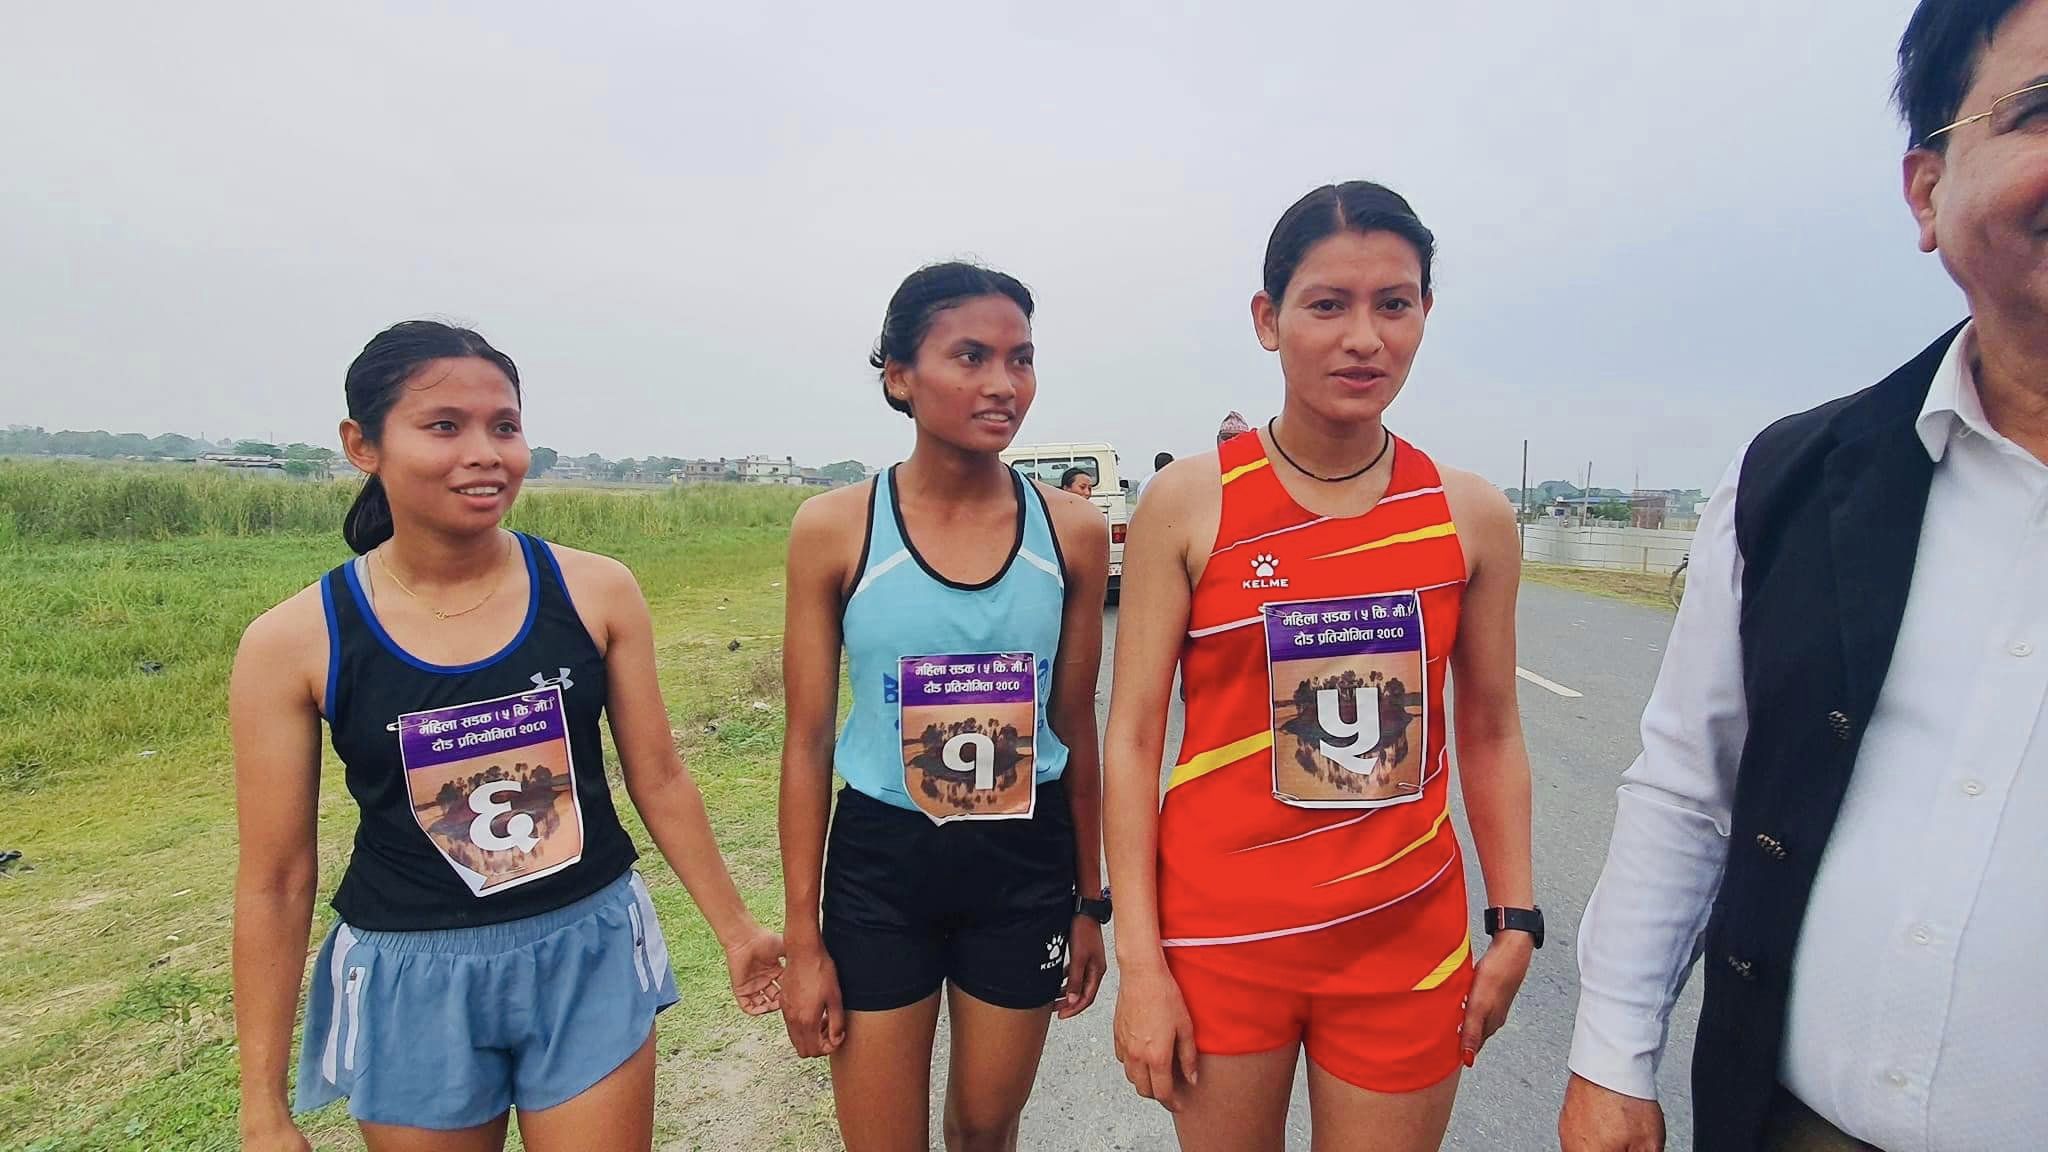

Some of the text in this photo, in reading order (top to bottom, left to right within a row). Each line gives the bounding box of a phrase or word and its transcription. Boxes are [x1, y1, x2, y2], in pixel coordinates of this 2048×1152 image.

[1242, 579, 1289, 589] KELME
[1283, 612, 1318, 626] महिला
[1321, 610, 1352, 624] सडक
[1318, 627, 1373, 645] प्रतियोगिता
[1376, 627, 1404, 639] २०८०
[915, 662, 947, 676] महिला
[949, 663, 975, 674] सडक
[944, 679, 993, 694] प्रतियोगिता
[995, 680, 1020, 691] २०८०
[419, 720, 457, 737] महिला
[461, 712, 492, 728] सडक
[458, 727, 517, 749] प्रतियोगिता
[519, 720, 547, 735] २०८०
[1316, 687, 1381, 775] ५
[942, 733, 995, 789] १
[468, 780, 542, 853] ६
